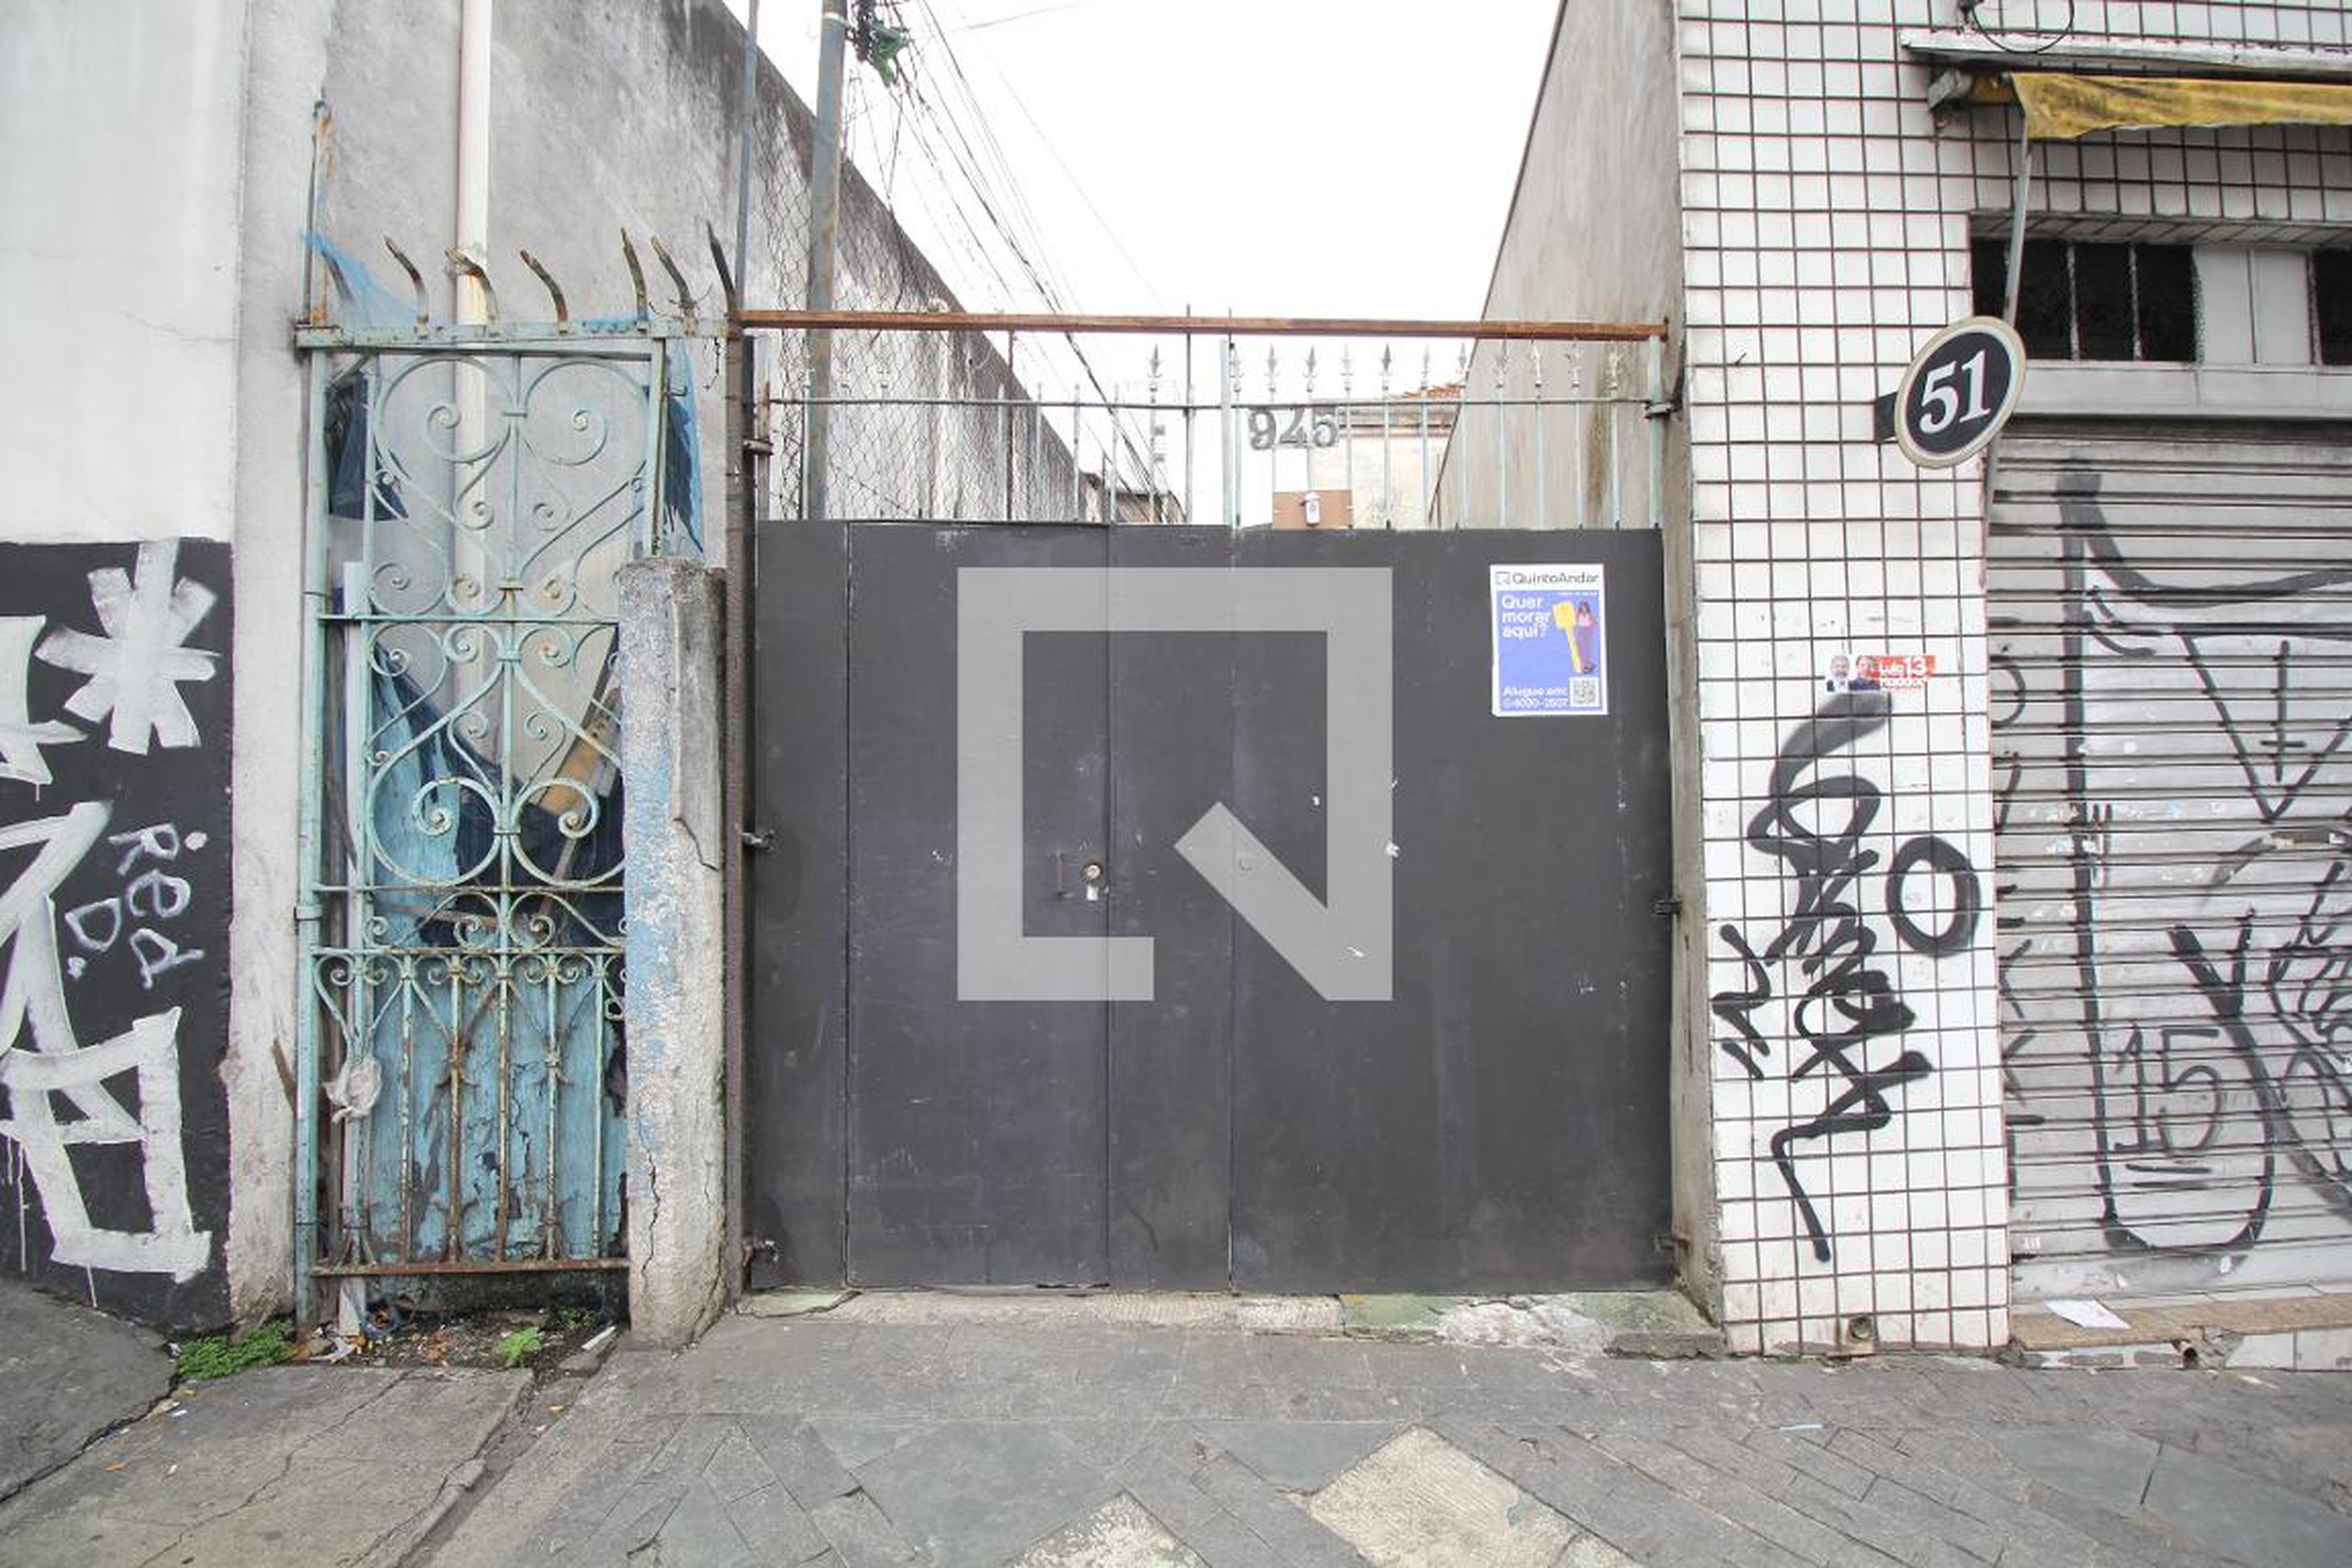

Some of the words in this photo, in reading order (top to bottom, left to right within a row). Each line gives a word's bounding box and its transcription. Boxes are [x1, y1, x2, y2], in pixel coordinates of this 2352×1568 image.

[1919, 349, 1991, 434] 51
[1512, 572, 1600, 585] QuintoAndar
[1501, 595, 1545, 609] Quer
[1501, 612, 1551, 624] morar
[1501, 624, 1547, 639] aqui?
[1903, 657, 1928, 677] 13
